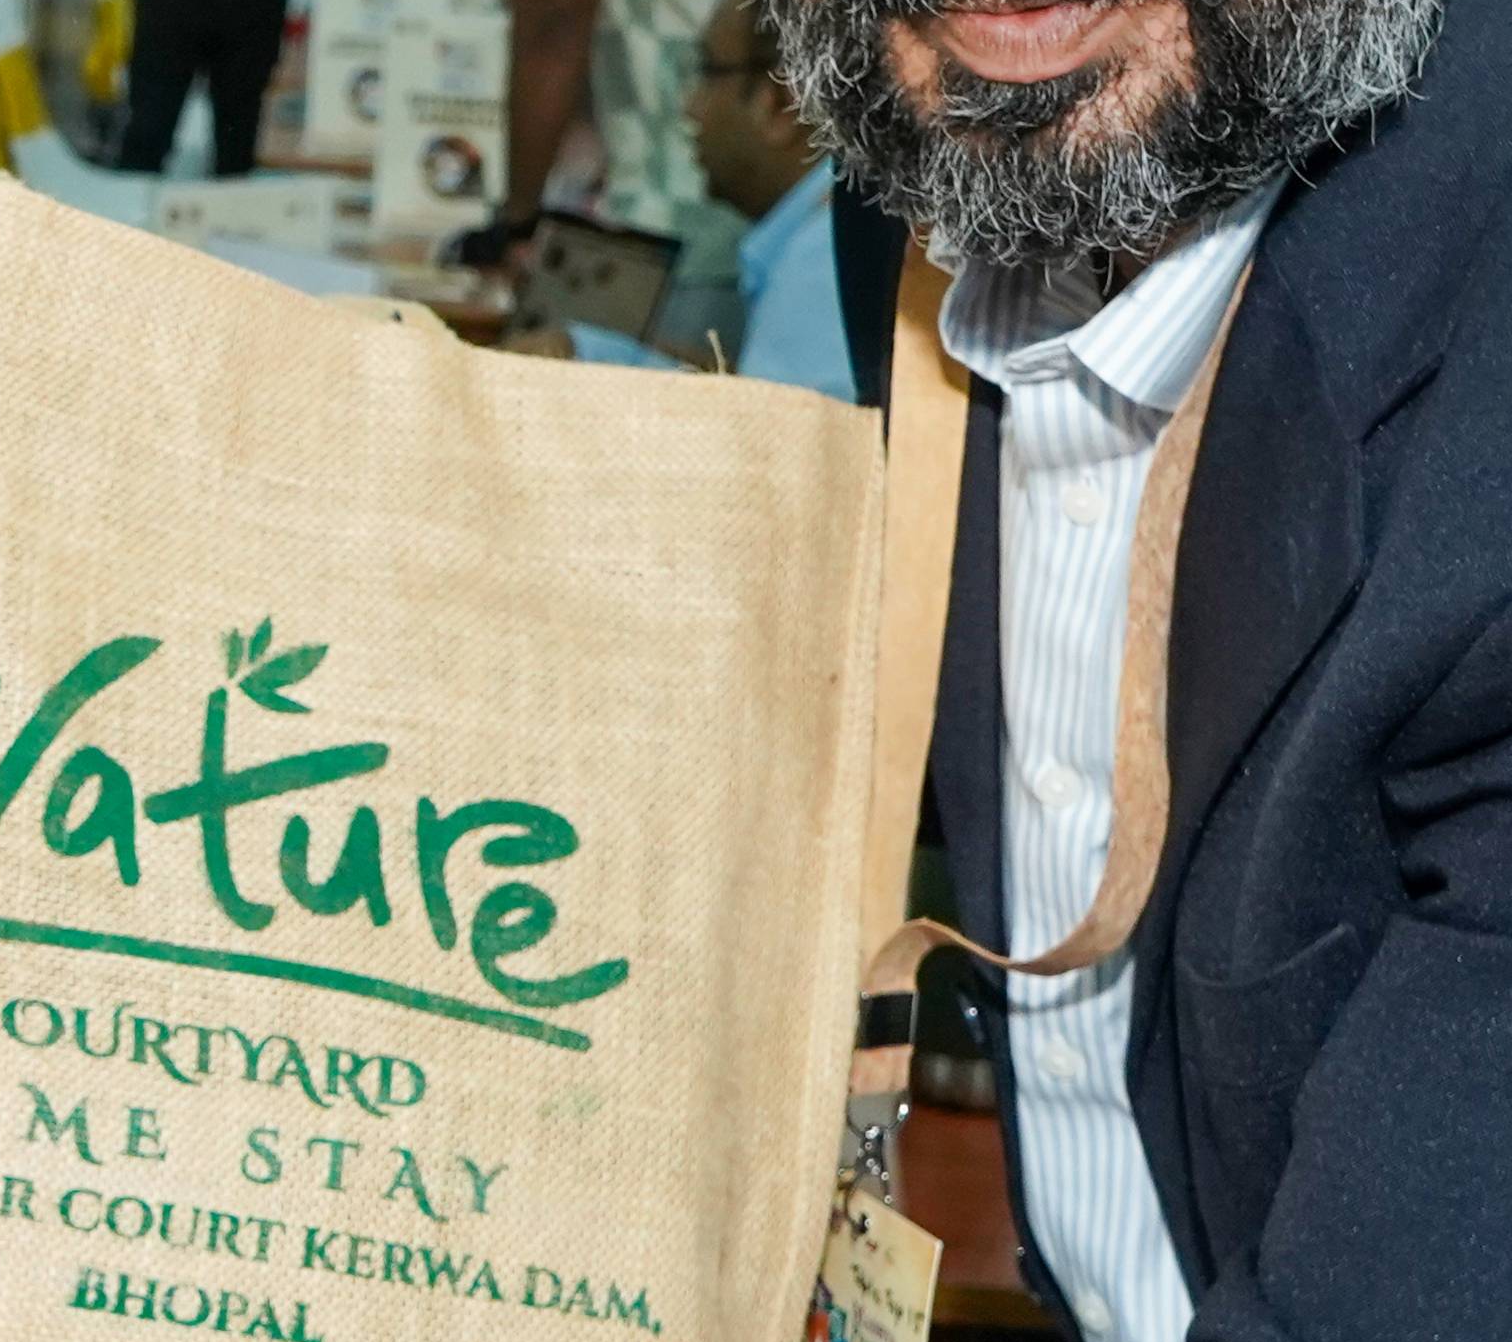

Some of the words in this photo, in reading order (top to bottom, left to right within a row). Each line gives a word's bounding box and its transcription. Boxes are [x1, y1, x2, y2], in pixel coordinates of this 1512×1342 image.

[239, 1127, 510, 1222] STAY
[56, 1187, 288, 1262] COURT
[300, 1226, 506, 1301] KERWA
[521, 1265, 664, 1336] DAM,
